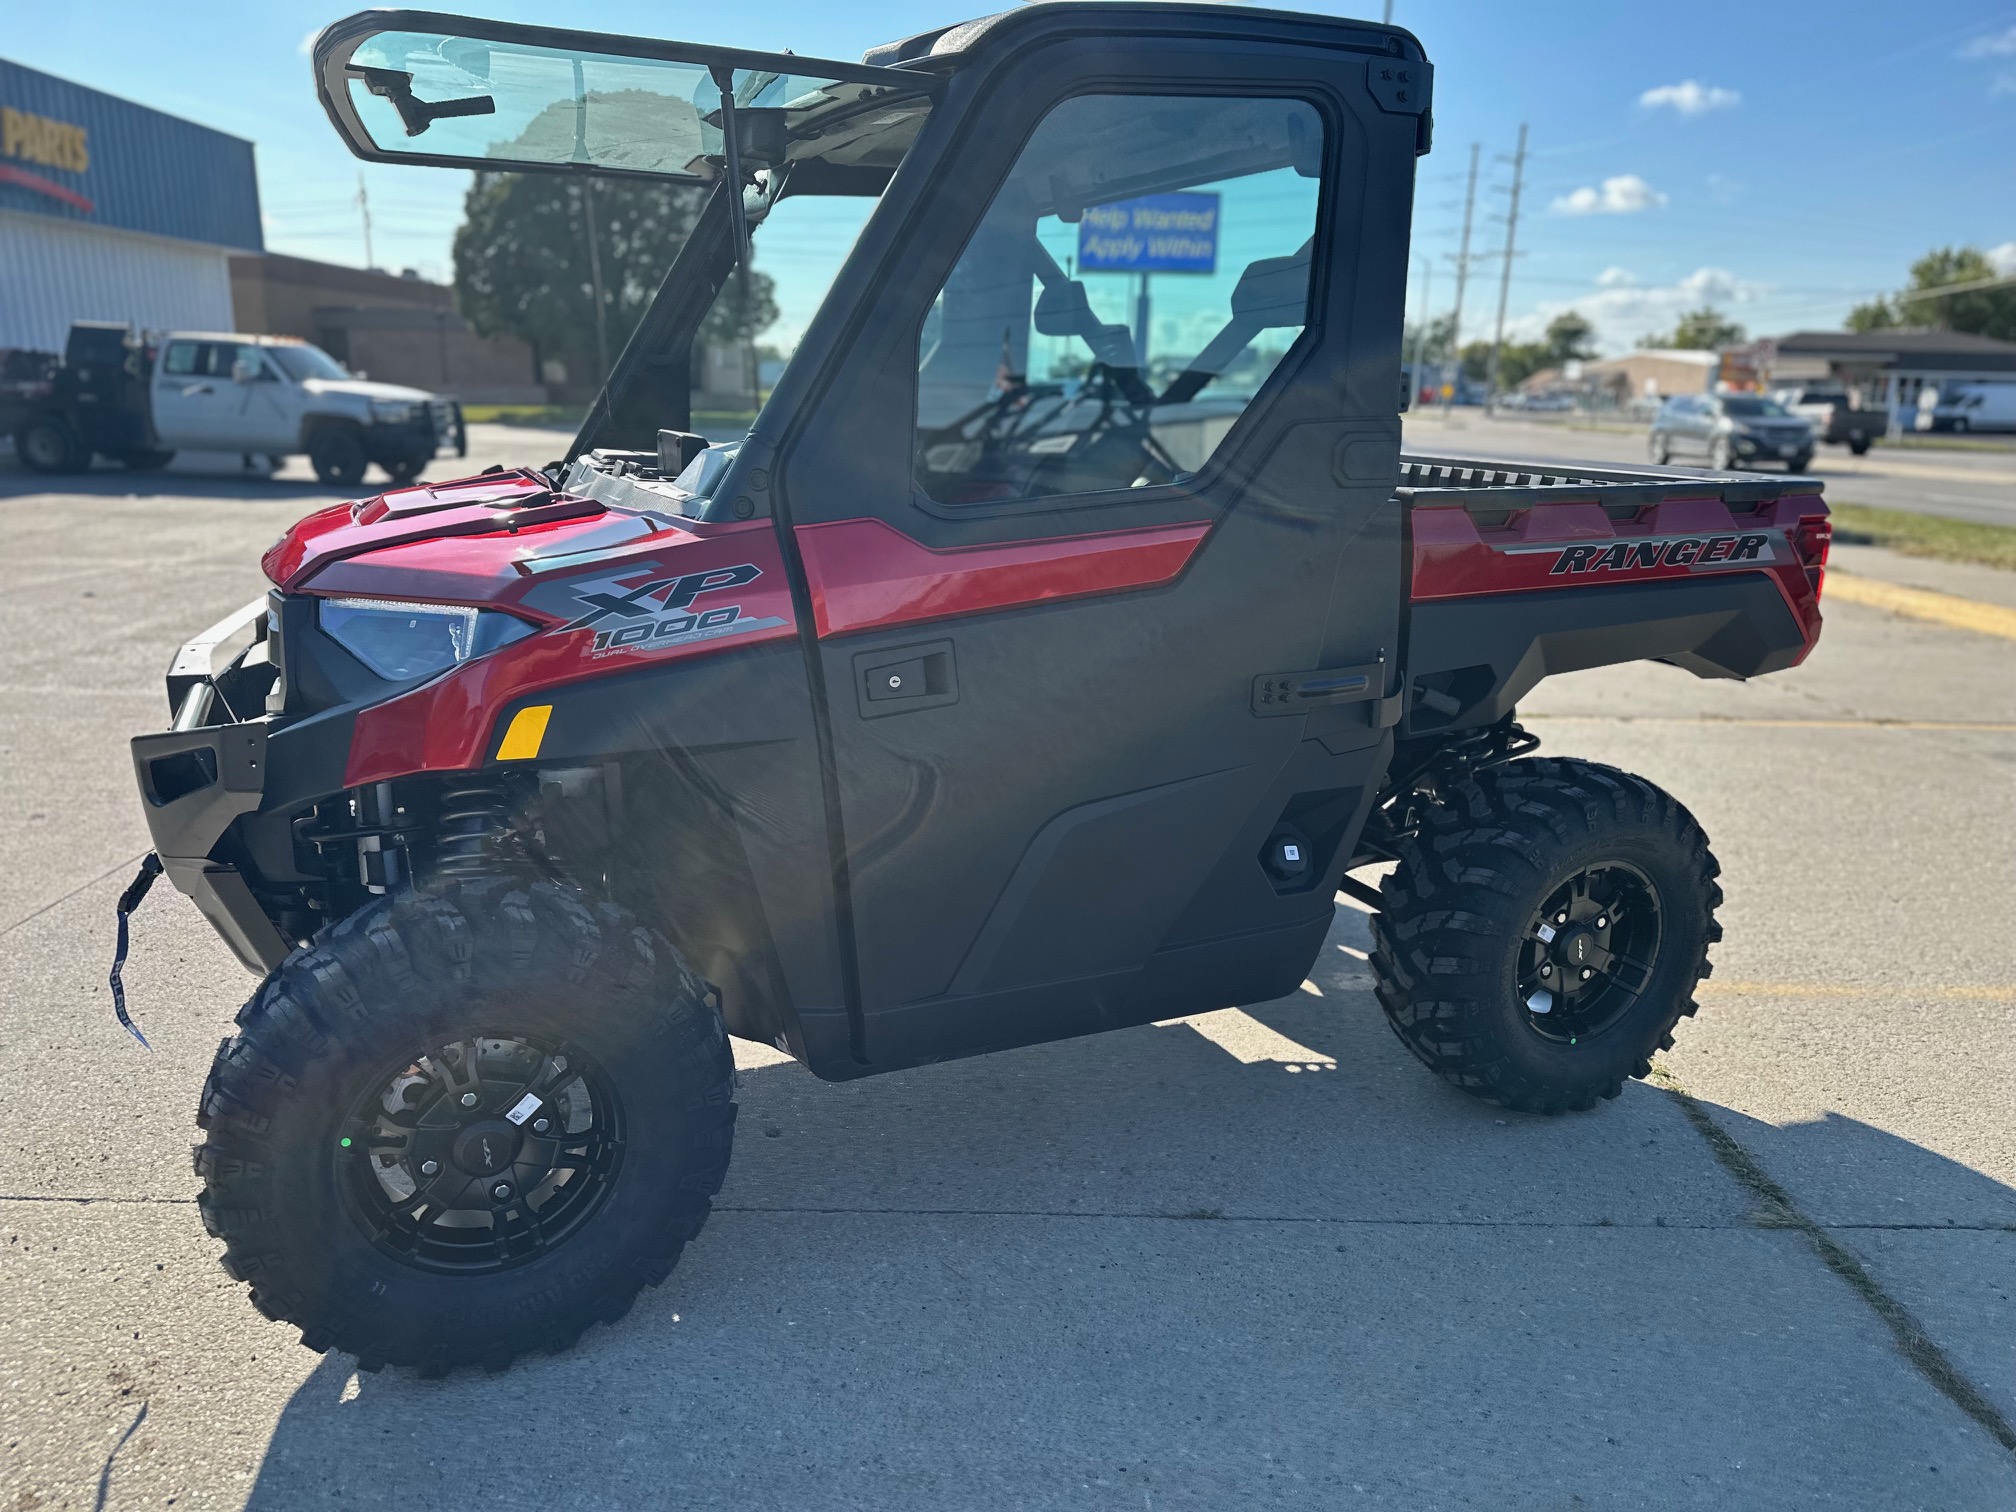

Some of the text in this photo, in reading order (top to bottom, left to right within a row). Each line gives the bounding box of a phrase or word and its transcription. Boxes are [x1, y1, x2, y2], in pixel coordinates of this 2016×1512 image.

[3, 106, 89, 174] PARTS
[1132, 207, 1216, 231] Wanted
[1083, 234, 1212, 262] Apply Within
[1548, 534, 1769, 575] RANGER
[543, 563, 764, 637] XP
[591, 604, 742, 653] 1000
[592, 626, 734, 660] DUAL OVERHEAD CAM
